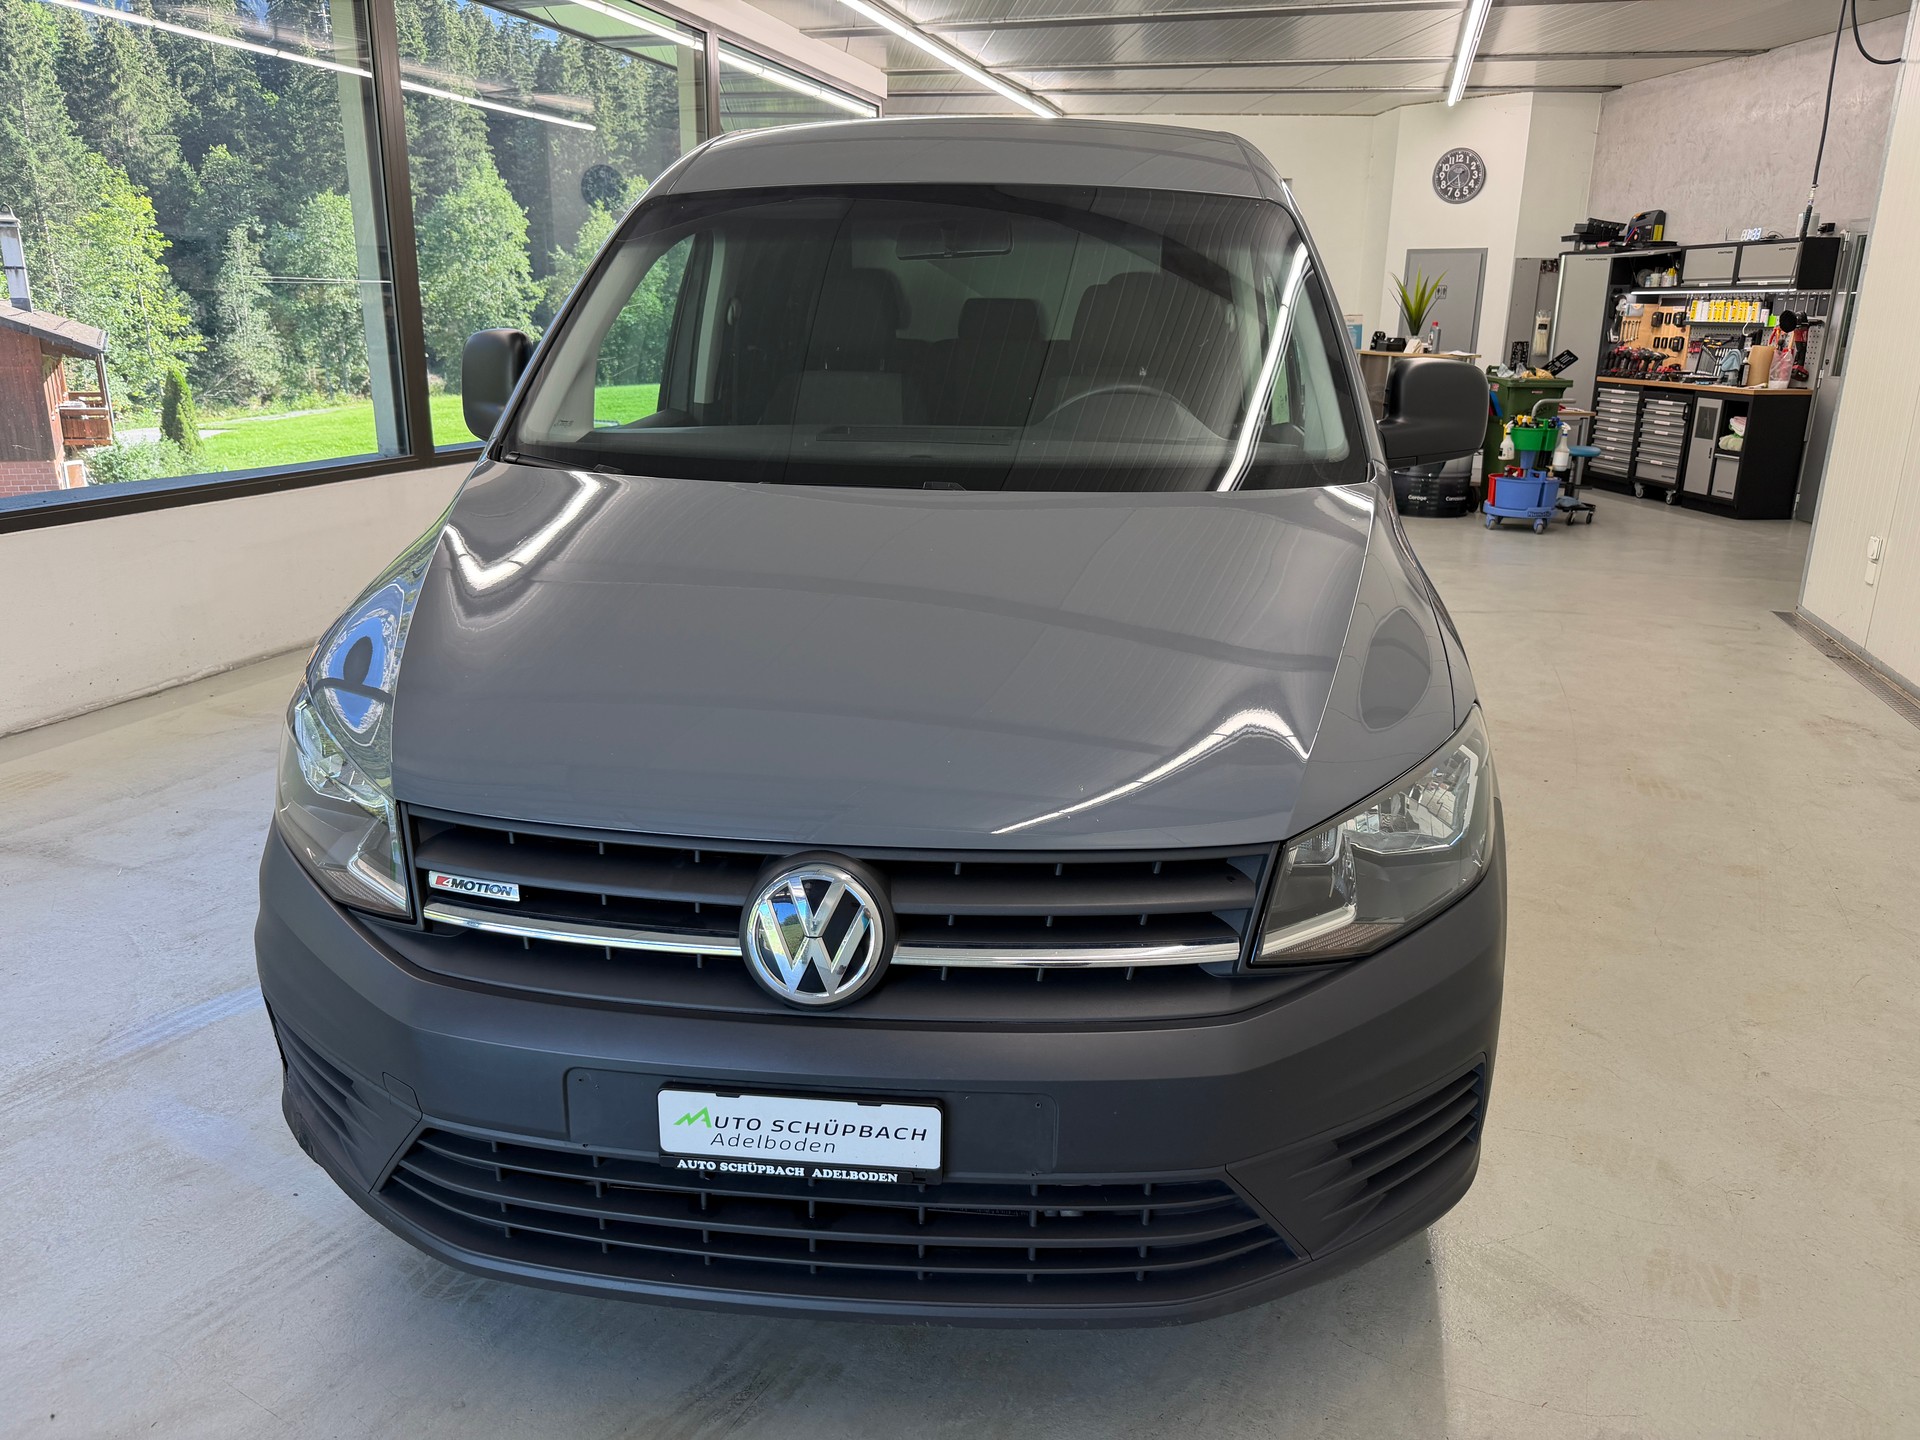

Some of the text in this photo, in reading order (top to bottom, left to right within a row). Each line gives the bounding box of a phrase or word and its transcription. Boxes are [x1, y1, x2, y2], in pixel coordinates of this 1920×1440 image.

[1470, 162, 1476, 170] 2
[1439, 172, 1445, 180] 9
[1440, 180, 1446, 188] 8
[1469, 179, 1474, 188] 4
[1448, 188, 1452, 196] 7
[1454, 188, 1460, 197] 6
[1462, 186, 1468, 194] 5
[440, 877, 513, 896] 4MOTION
[753, 865, 876, 1001] VW
[771, 1118, 928, 1141] SCHÜPBACH
[710, 1132, 836, 1154] Adelboden
[676, 1158, 898, 1182] AUTO SCHÜPBACH ADELBODEN
